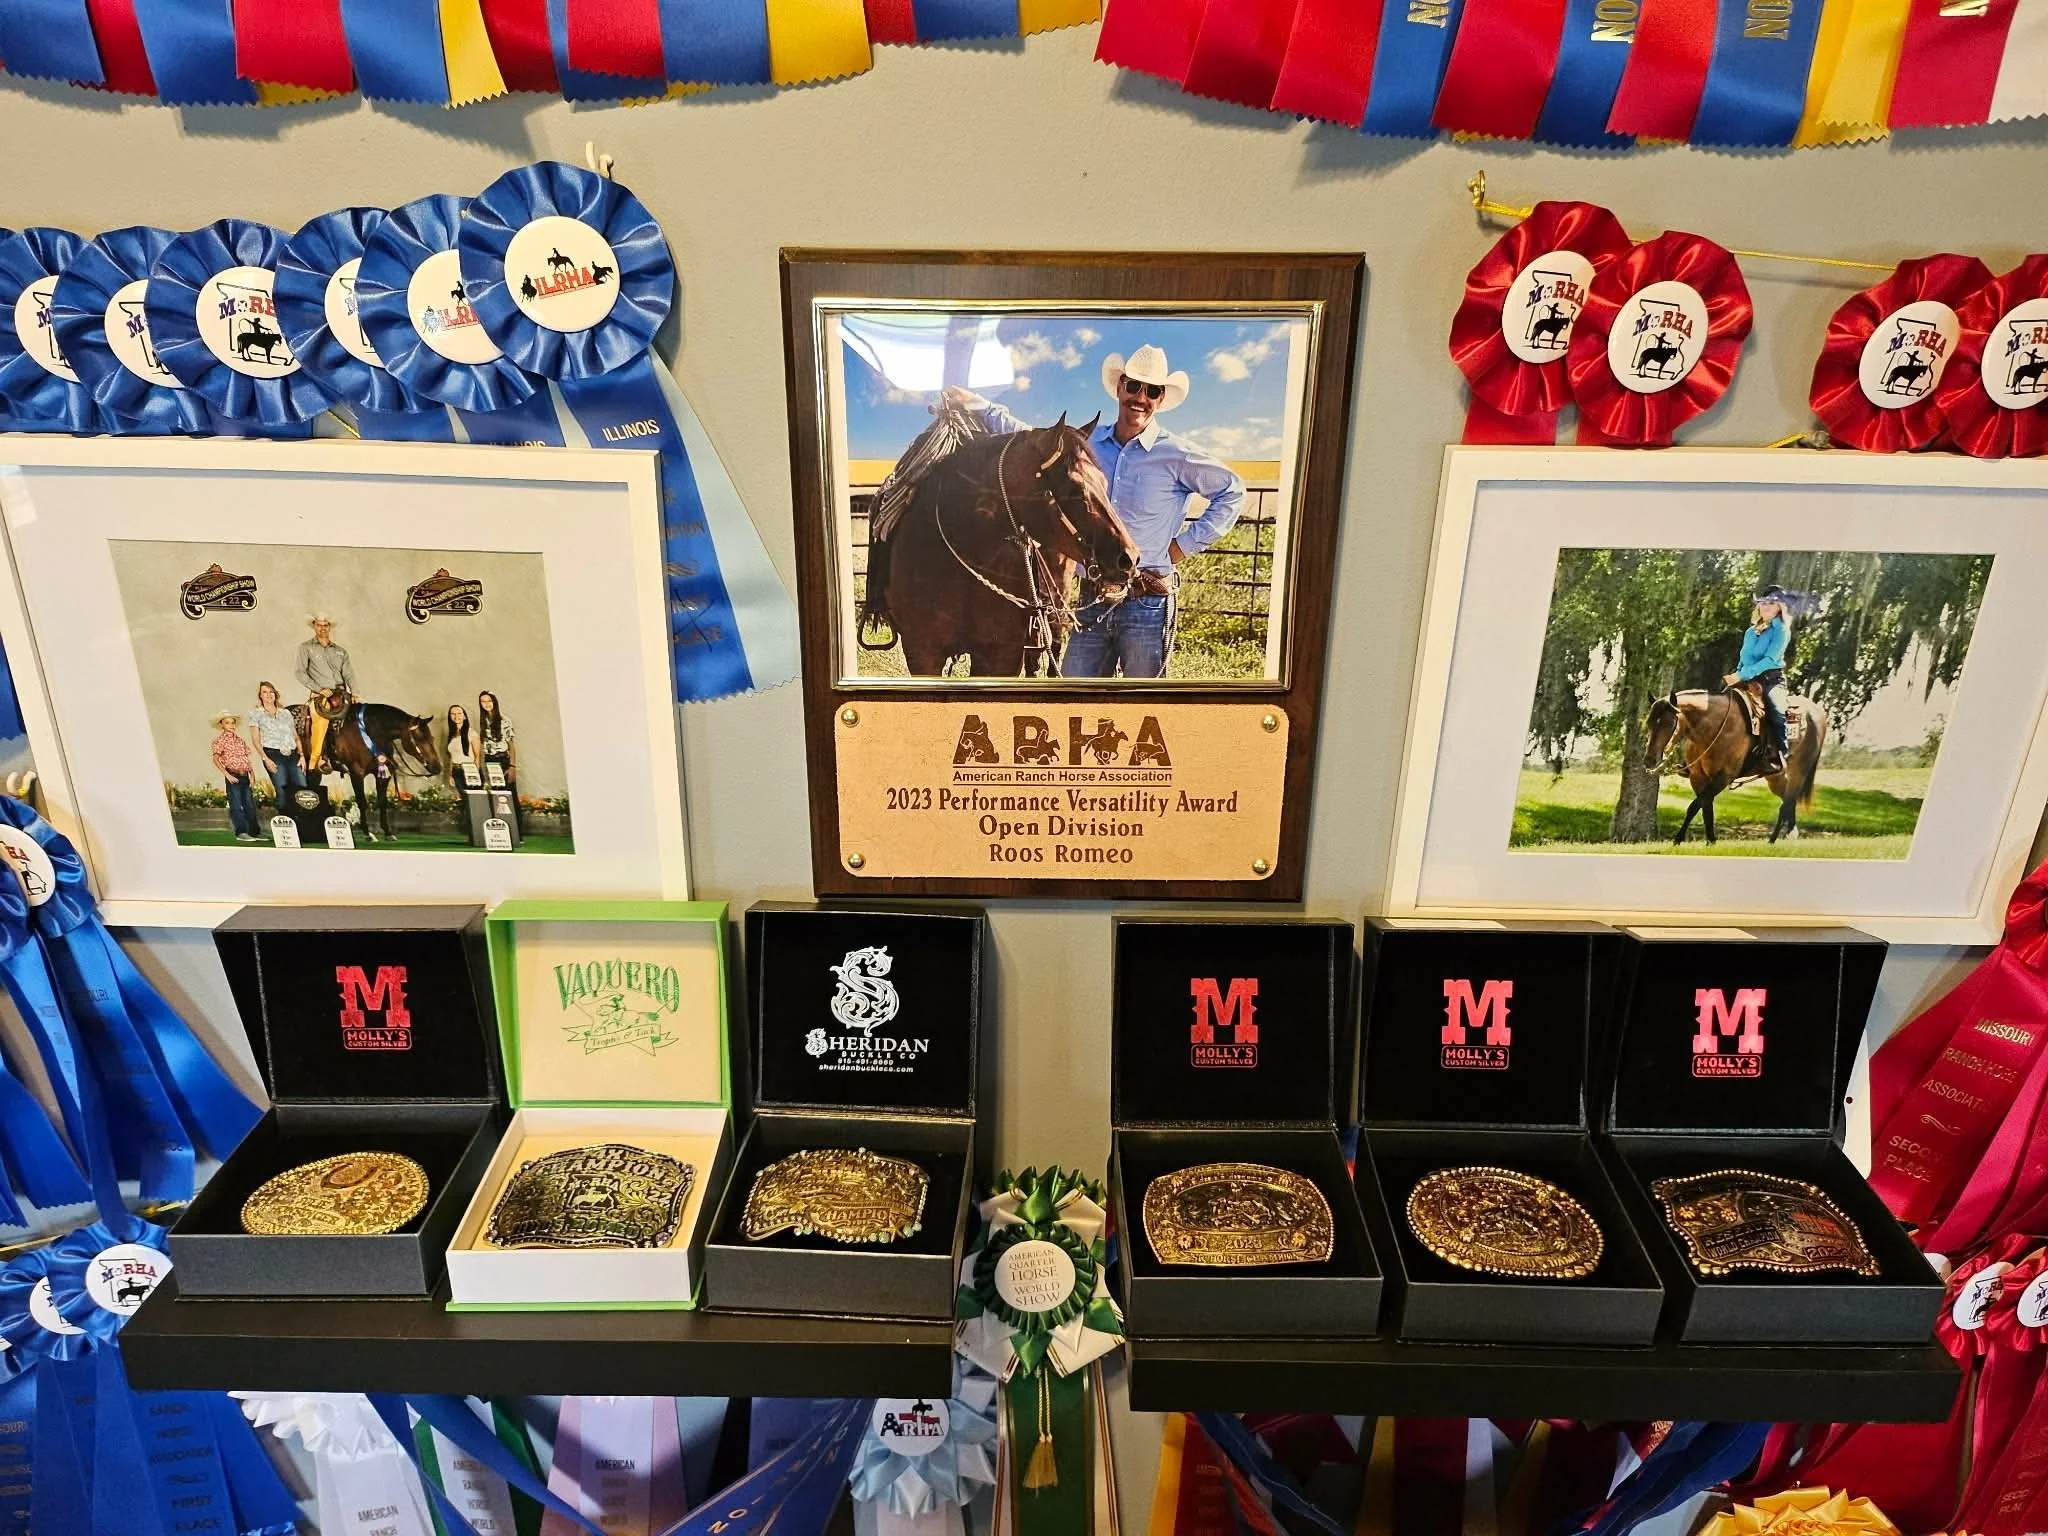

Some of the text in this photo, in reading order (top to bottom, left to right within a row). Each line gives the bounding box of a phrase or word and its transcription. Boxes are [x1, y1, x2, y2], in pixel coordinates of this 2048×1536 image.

[532, 266, 596, 297] ILRHA
[602, 420, 660, 442] ILLINOIS
[952, 714, 1172, 766] ARHA
[953, 771, 1173, 782] American Ranch Horse Association
[887, 787, 1238, 817] 2023 Performance Versatility Award
[979, 814, 1144, 840] Open Division
[989, 844, 1134, 864] Roos Romeo
[553, 960, 680, 1014] VAQUERO
[335, 966, 411, 1027] M
[1191, 977, 1258, 1043] M
[1441, 979, 1513, 1046] M
[1692, 988, 1767, 1054] M
[347, 1031, 407, 1041] MOLLY'S
[1974, 1017, 2034, 1047] MISSOURI
[805, 1028, 930, 1058] SHERIDAN
[899, 1052, 916, 1060] CO
[1195, 1047, 1254, 1058] MOLLY'S
[1445, 1049, 1505, 1060] MOLLY'S
[818, 1064, 914, 1073] sheridanbuckleco.com
[1696, 1057, 1758, 1068] MOLLY'S
[1008, 1248, 1054, 1261] AMERICAN
[1008, 1257, 1057, 1270] QUARTER
[1011, 1265, 1057, 1281] HORSE
[1014, 1280, 1060, 1295] WORLD
[1015, 1292, 1060, 1306] SHOW
[358, 1505, 399, 1522] AMERICAN
